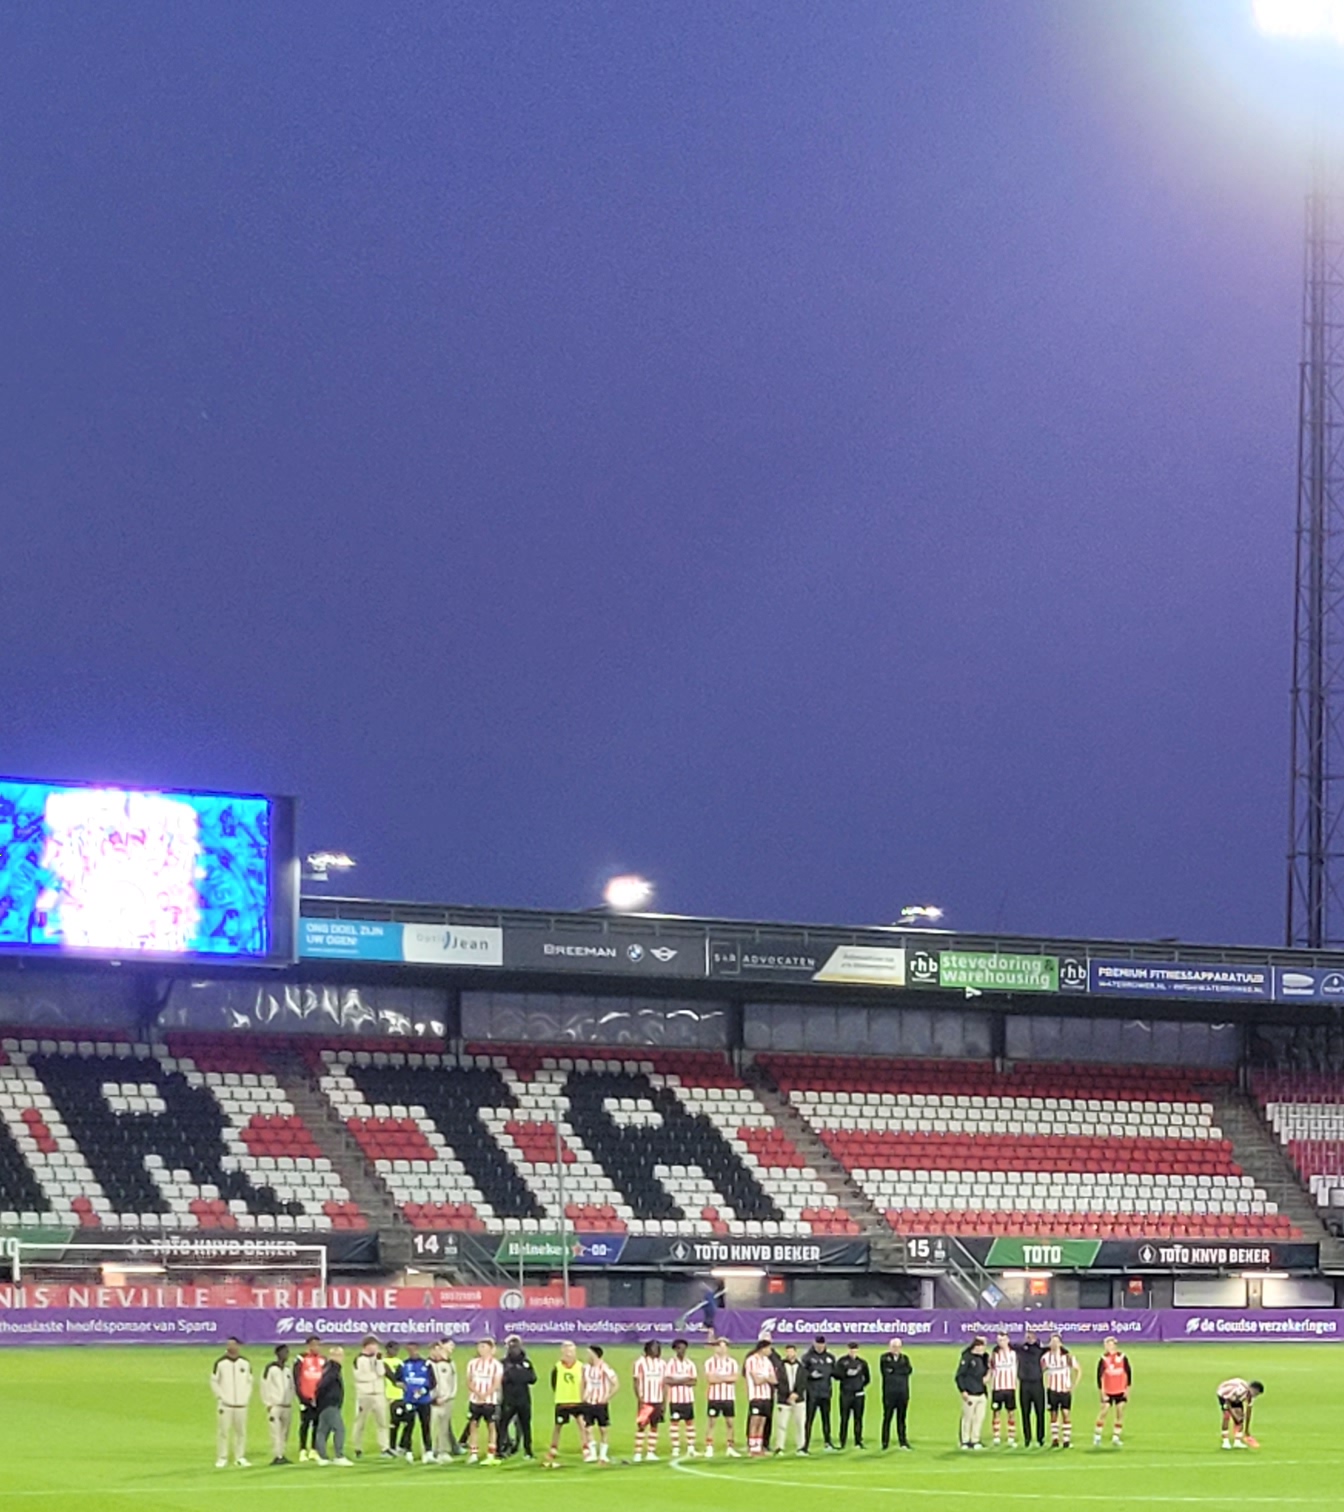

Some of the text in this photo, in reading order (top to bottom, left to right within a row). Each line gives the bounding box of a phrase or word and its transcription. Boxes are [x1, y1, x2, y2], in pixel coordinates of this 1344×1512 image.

[451, 936, 489, 950] Jean
[544, 944, 616, 958] BREEMAN
[742, 954, 816, 967] ADVOCATEN
[910, 957, 939, 973] rhb
[942, 954, 1042, 972] stevedoring
[942, 969, 1050, 989] warehousing
[1060, 965, 1087, 980] rhb
[1098, 967, 1148, 979] PREMIUM
[413, 1234, 440, 1255] 14
[693, 1242, 820, 1262] TOTO KNVB BEKER
[907, 1239, 930, 1258] 15
[1023, 1245, 1062, 1264] TOTO
[1159, 1245, 1271, 1264] TOTO KNVB BEKER
[69, 1287, 399, 1309] NEVILLE TRIBUNE
[66, 1319, 153, 1340] hoofdsponsor
[154, 1321, 176, 1333] van
[178, 1319, 217, 1337] Sparta
[295, 1318, 471, 1339] de Goudse verzekeringen
[504, 1320, 576, 1333] enthousiaste
[777, 1317, 931, 1340] de Goudse verzekeringen
[1200, 1317, 1337, 1335] de Goudse verzekeringen
